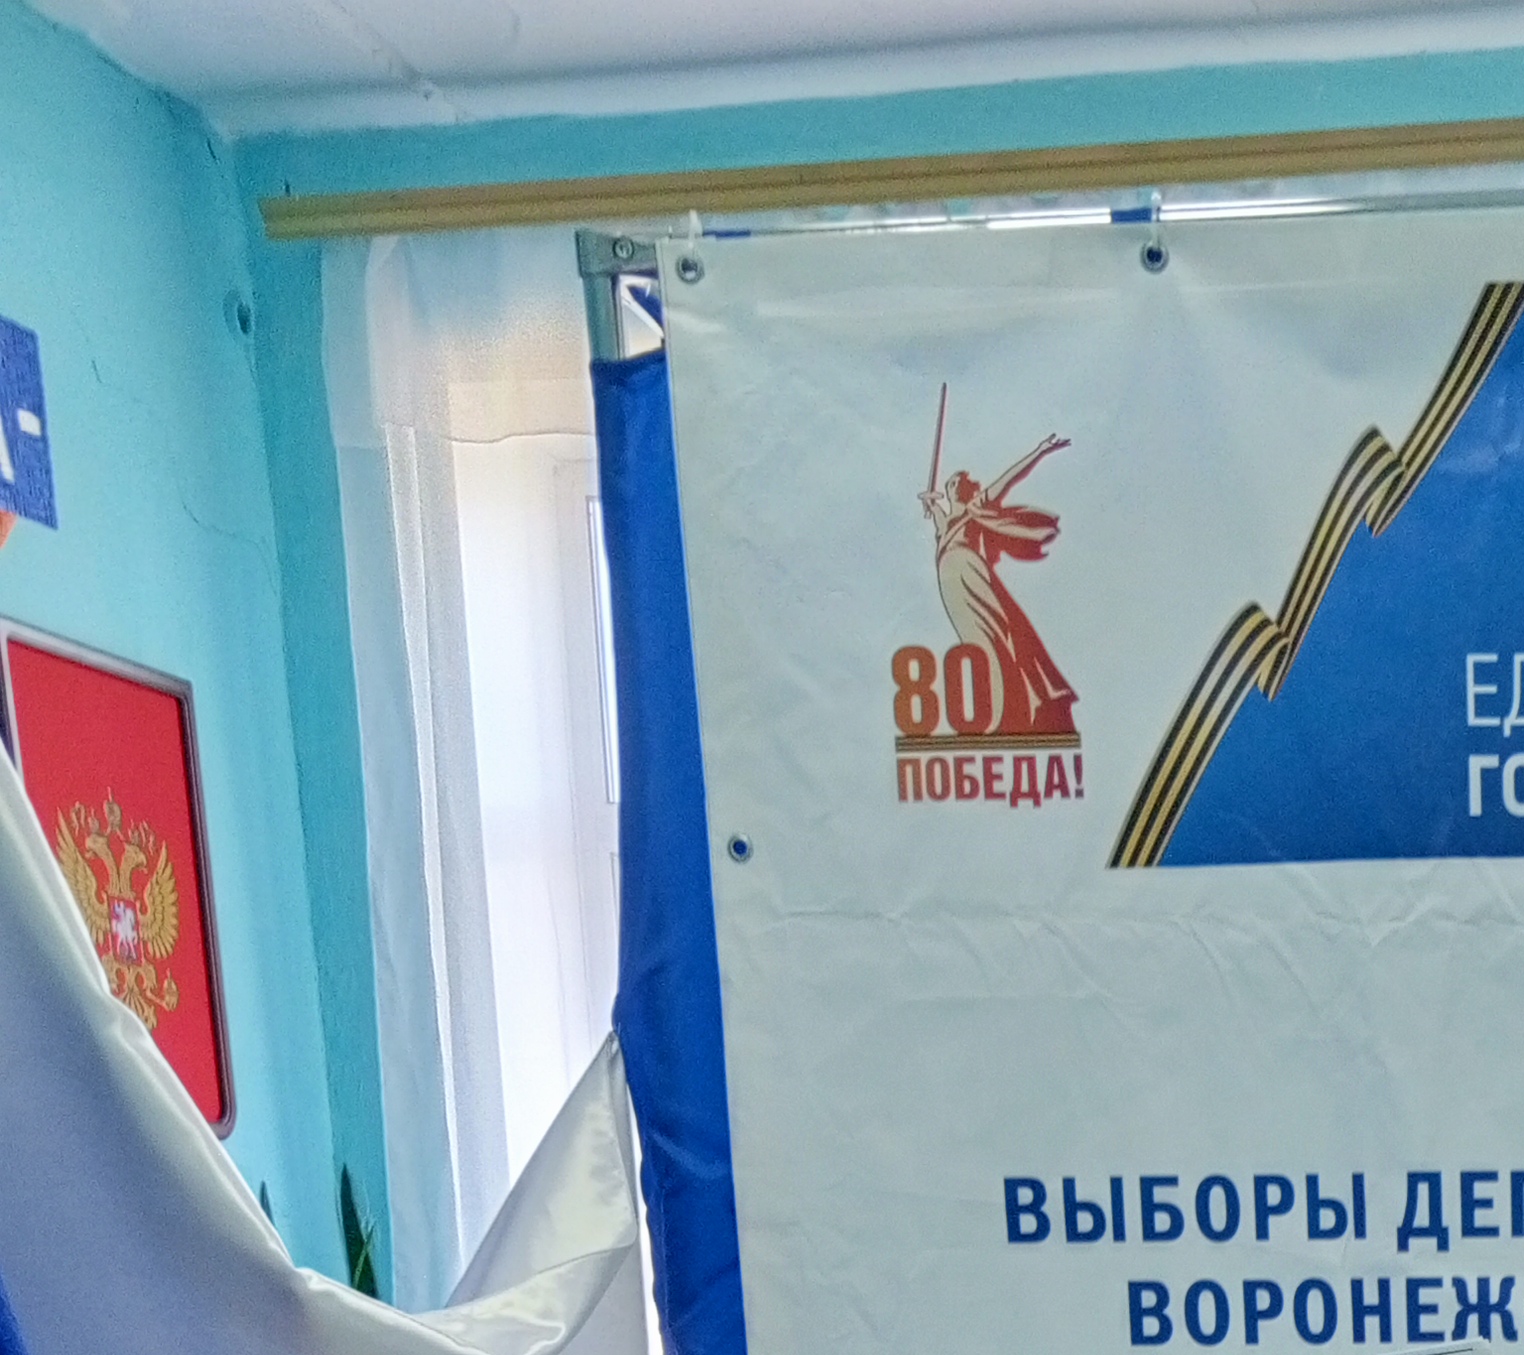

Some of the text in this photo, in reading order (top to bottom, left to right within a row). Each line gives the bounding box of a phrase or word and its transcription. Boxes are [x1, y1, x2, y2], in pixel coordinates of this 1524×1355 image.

[892, 643, 994, 736] 80
[897, 753, 1084, 807] ПОБЕДА!
[1004, 1175, 1367, 1244] ВЫБОРЫ
